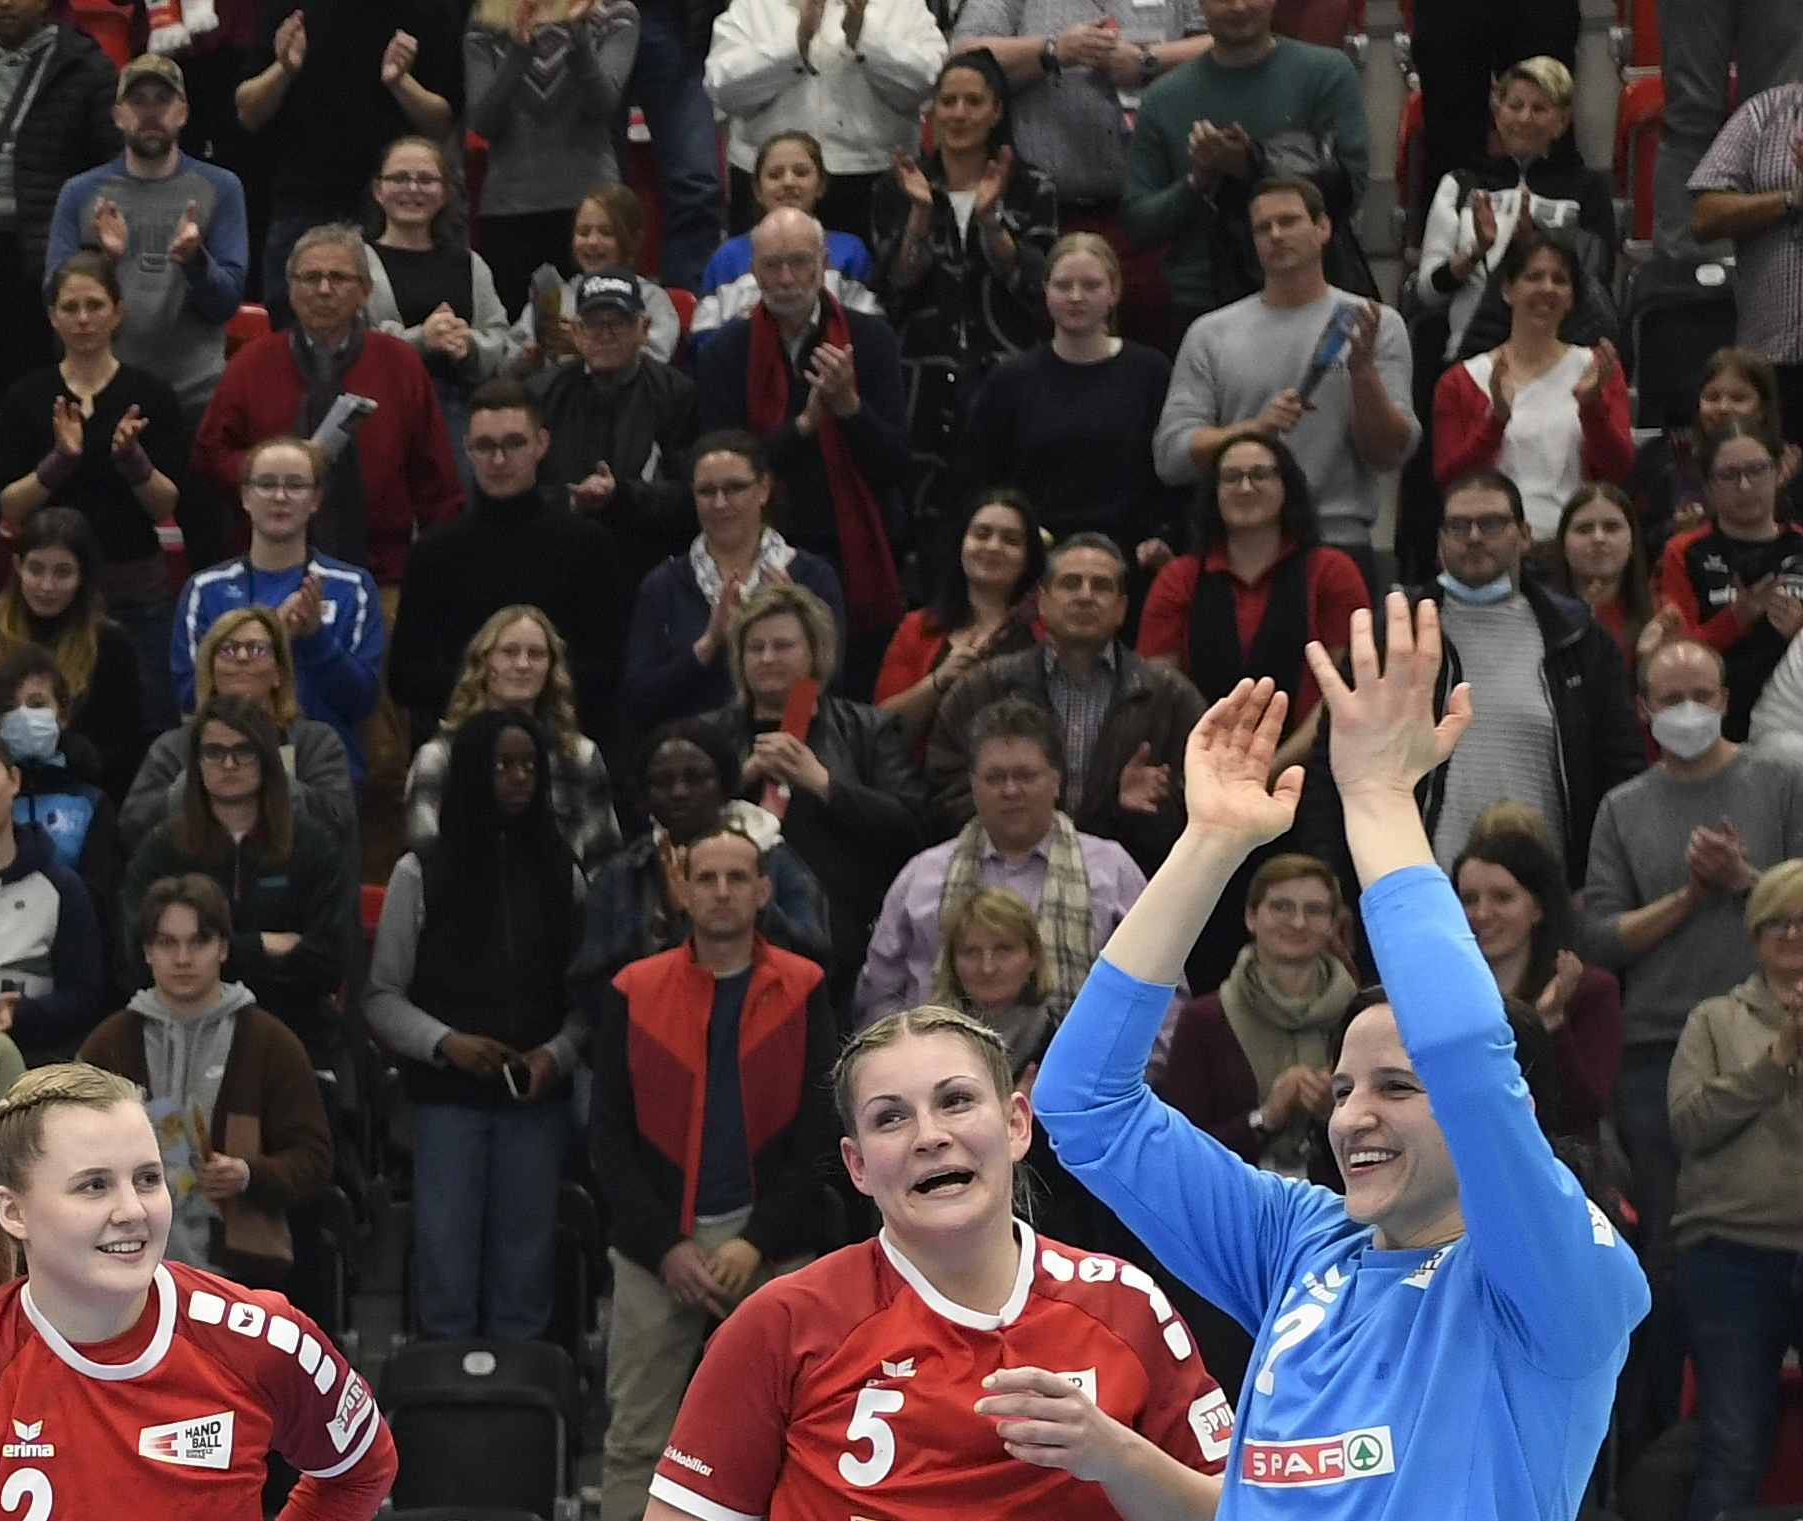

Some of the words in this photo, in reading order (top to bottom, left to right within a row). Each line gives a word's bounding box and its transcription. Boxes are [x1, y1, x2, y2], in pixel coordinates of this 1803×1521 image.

[184, 1420, 222, 1439] HAND
[838, 1388, 905, 1487] 5
[1, 1442, 56, 1458] erima
[191, 1434, 223, 1449] BALL
[1251, 1450, 1344, 1477] SPAR
